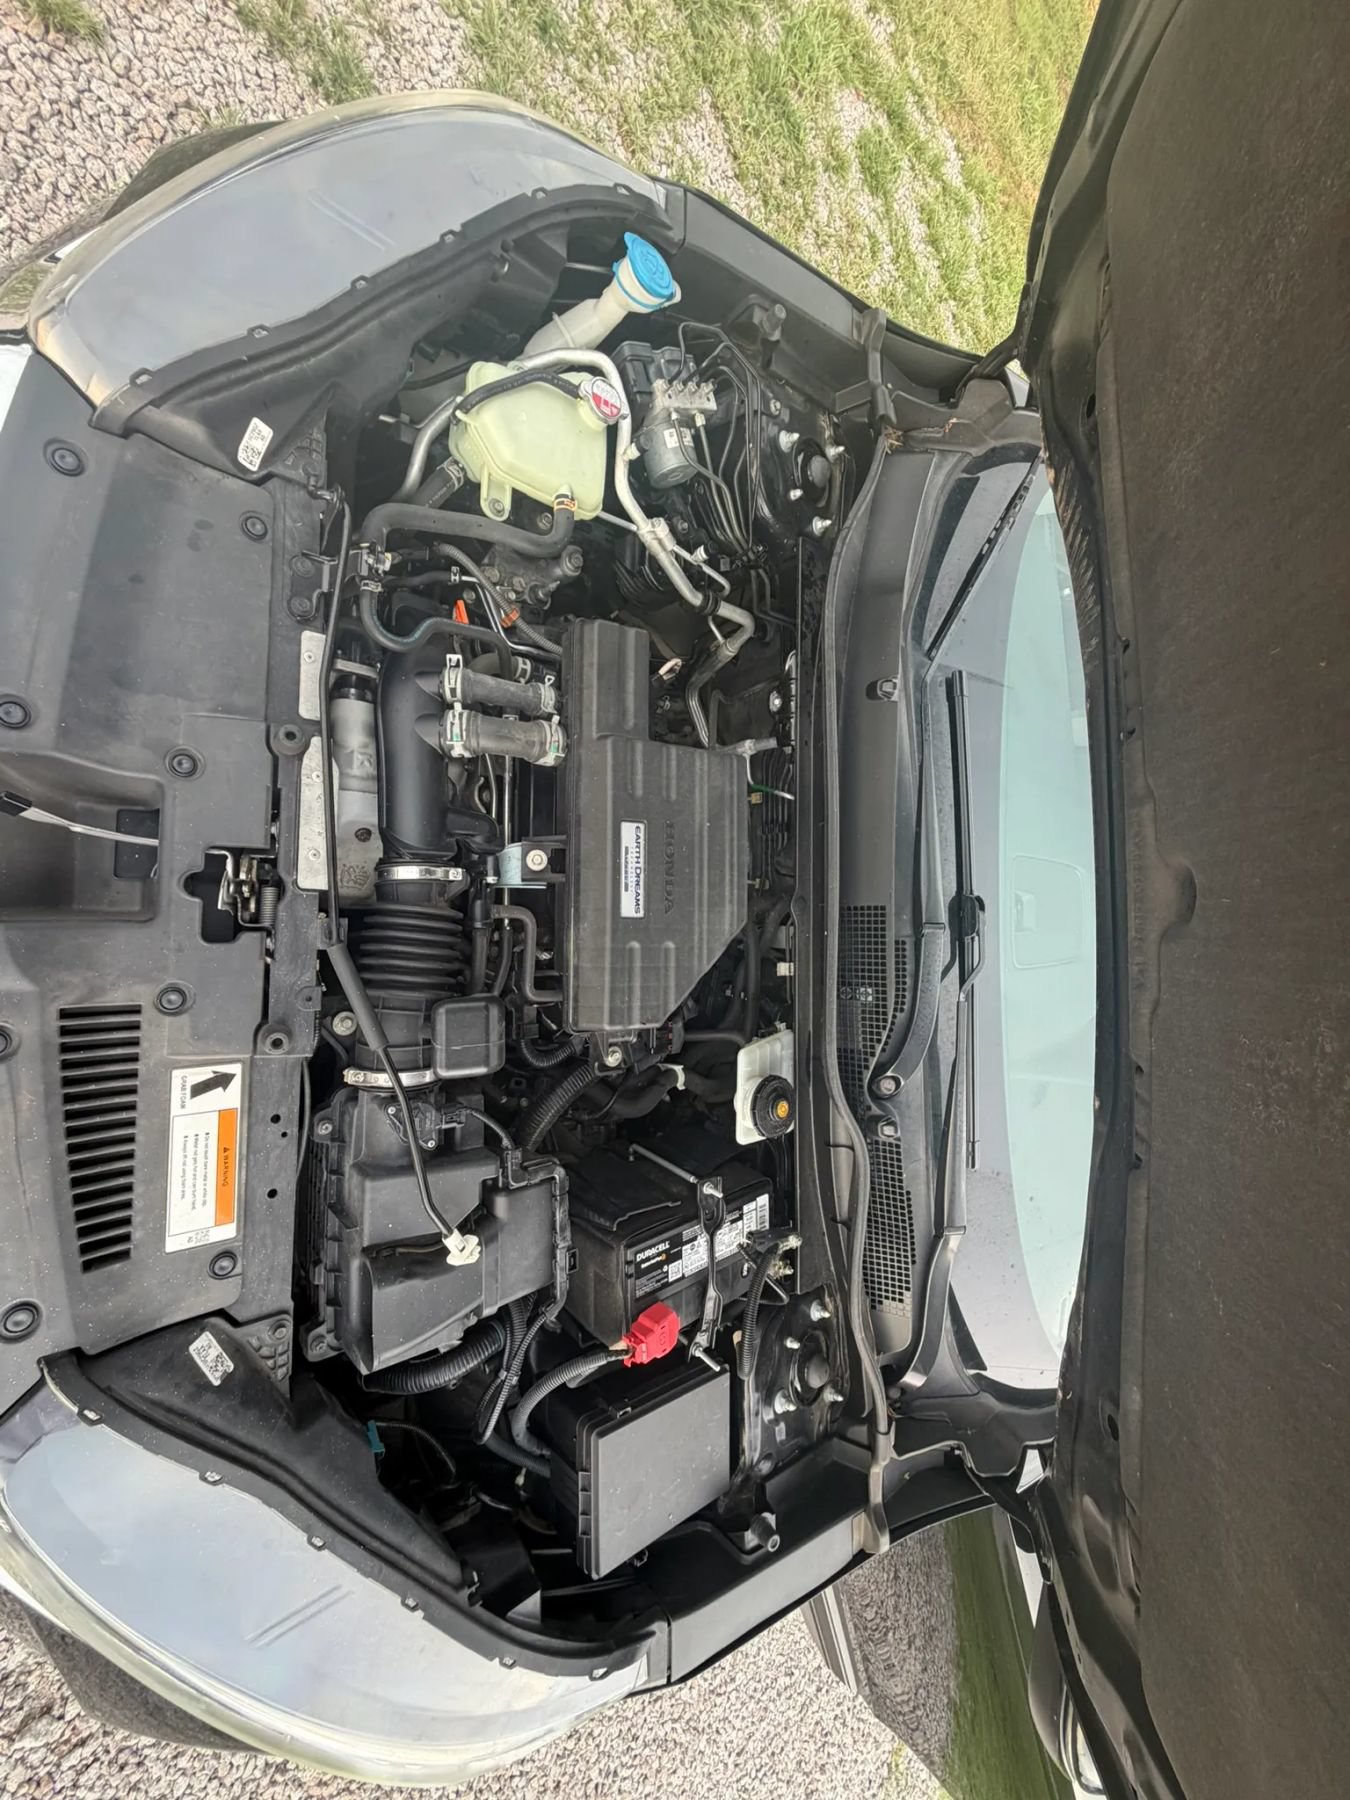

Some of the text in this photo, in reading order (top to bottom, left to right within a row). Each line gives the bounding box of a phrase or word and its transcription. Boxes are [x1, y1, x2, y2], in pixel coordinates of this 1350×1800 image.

[634, 825, 642, 914] EARTH DREAMS
[664, 820, 675, 914] HONDA
[180, 1075, 188, 1092] GRAB
[222, 1154, 230, 1187] WARNING
[636, 1240, 670, 1262] DURACELL
